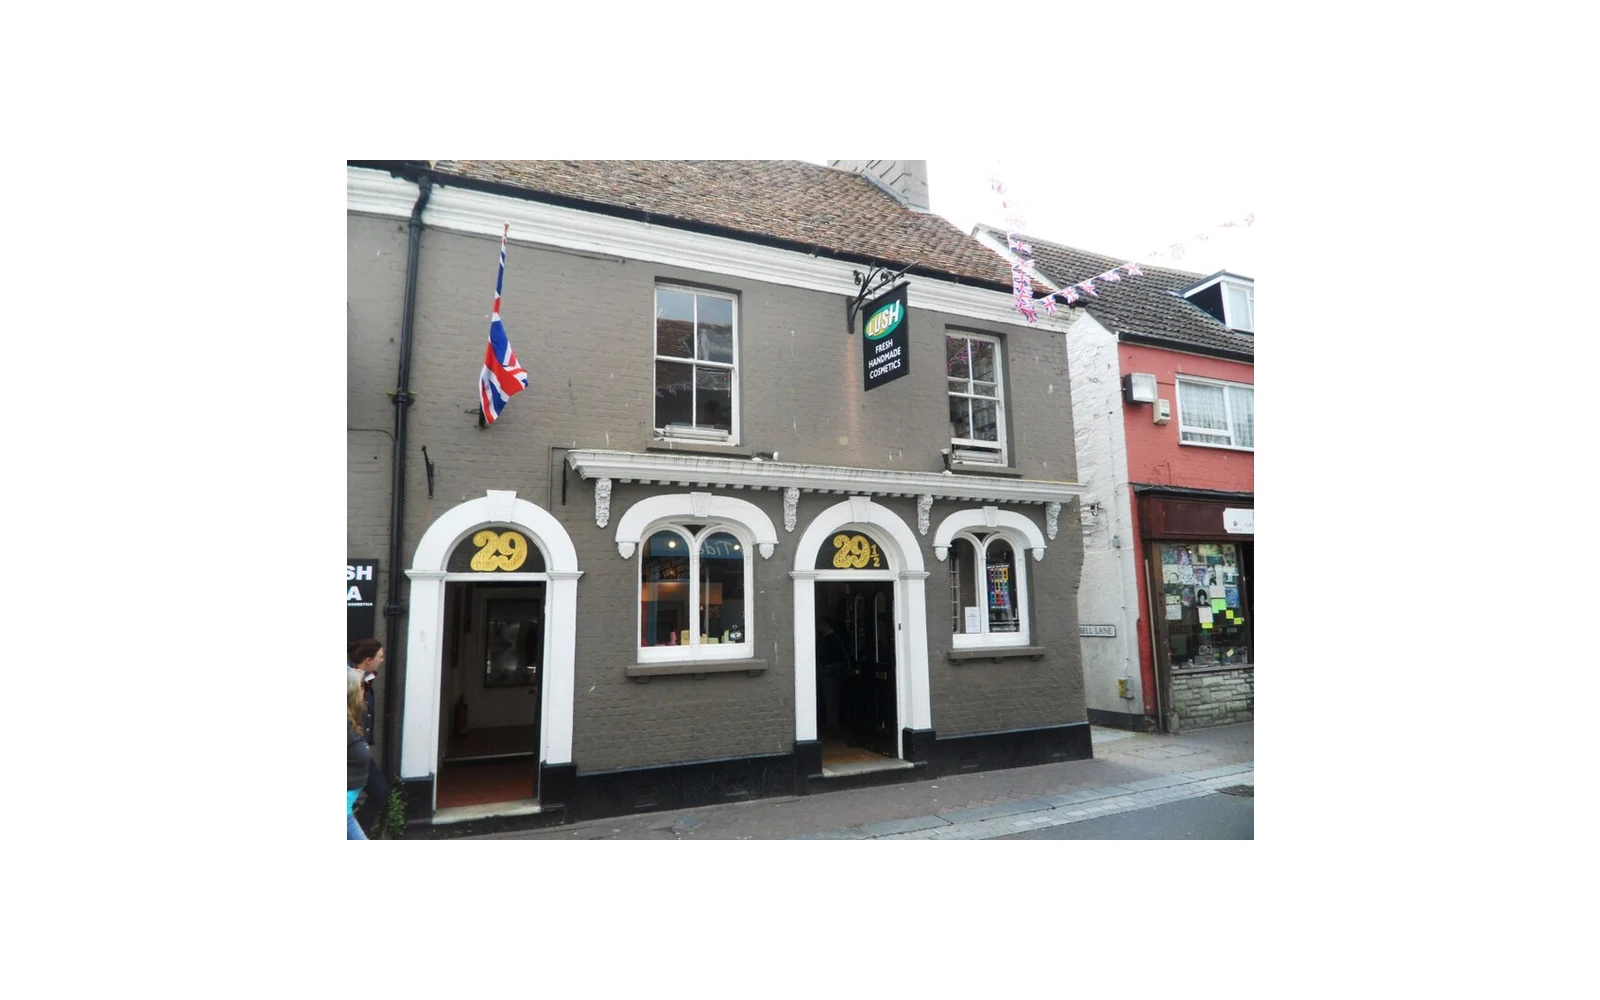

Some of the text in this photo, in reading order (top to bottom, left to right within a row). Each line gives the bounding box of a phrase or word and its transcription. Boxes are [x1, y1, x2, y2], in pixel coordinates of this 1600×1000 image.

[868, 299, 901, 337] LUSH
[875, 339, 893, 354] FRESH
[868, 347, 901, 368] HANDMADE
[869, 359, 901, 379] COSMETICS
[470, 530, 528, 572] 29
[833, 535, 870, 569] 29
[347, 565, 373, 581] SH
[1095, 627, 1113, 635] LANE
